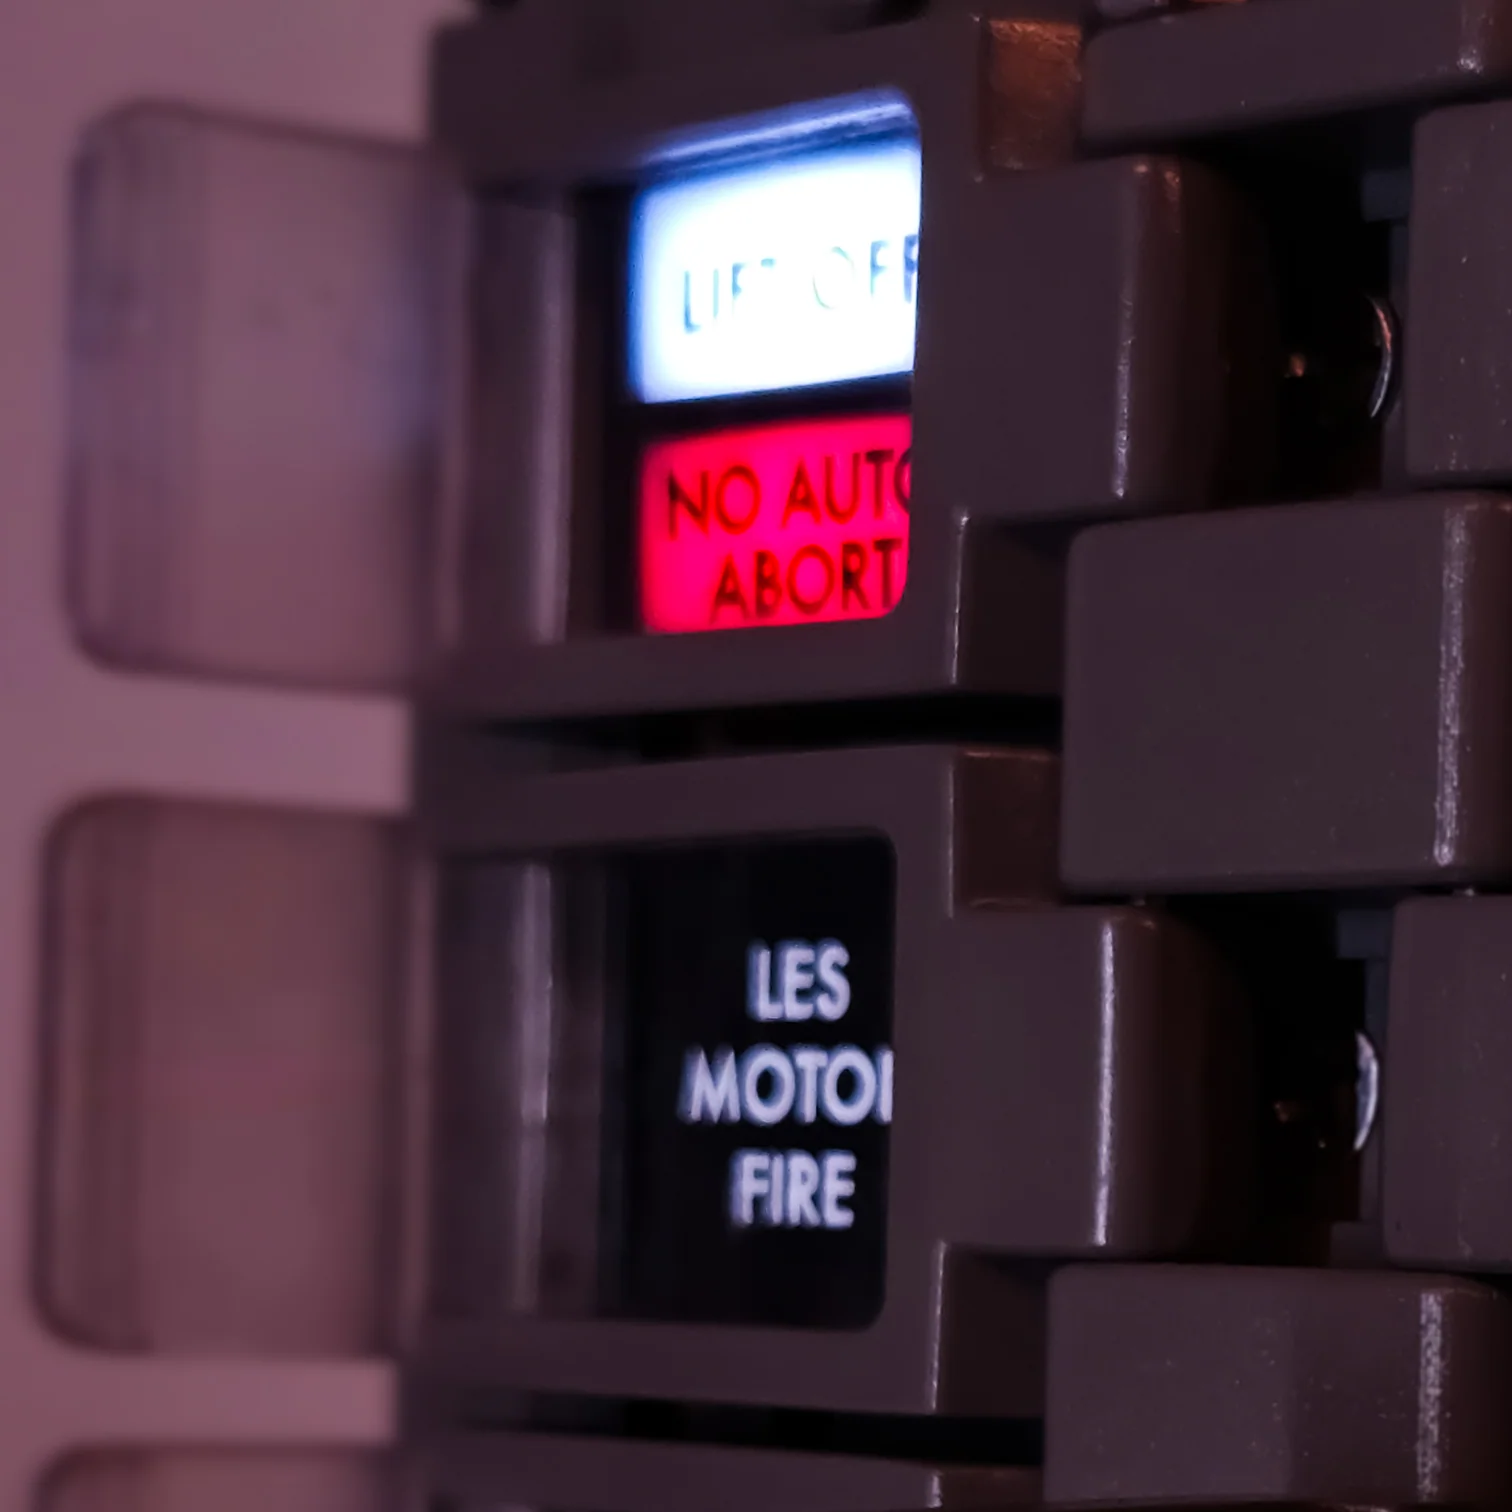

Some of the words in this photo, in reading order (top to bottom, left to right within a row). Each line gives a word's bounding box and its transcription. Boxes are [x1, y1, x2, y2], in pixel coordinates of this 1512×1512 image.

[683, 255, 778, 335] LIF
[667, 464, 763, 541] NO
[710, 536, 903, 624] ABORT
[746, 937, 852, 1023] LES
[730, 1147, 858, 1231] FIRE
